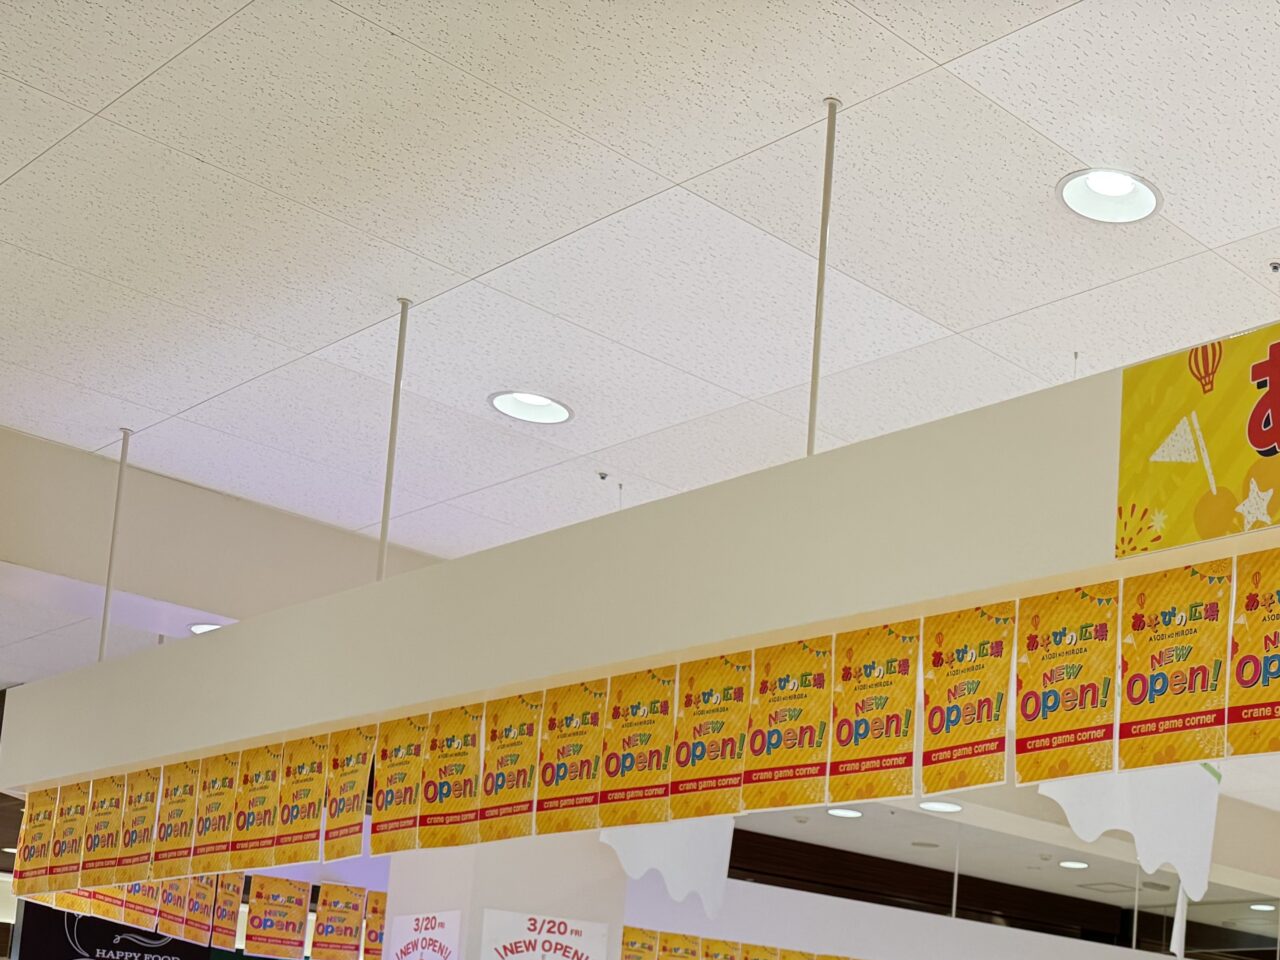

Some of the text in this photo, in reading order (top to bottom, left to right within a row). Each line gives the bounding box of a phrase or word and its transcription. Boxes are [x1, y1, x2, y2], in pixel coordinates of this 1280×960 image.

[413, 916, 437, 932] 3/20
[527, 917, 583, 938] 3/20 FRI
[400, 937, 449, 960] NEW OPEN!
[501, 940, 538, 958] NEW
